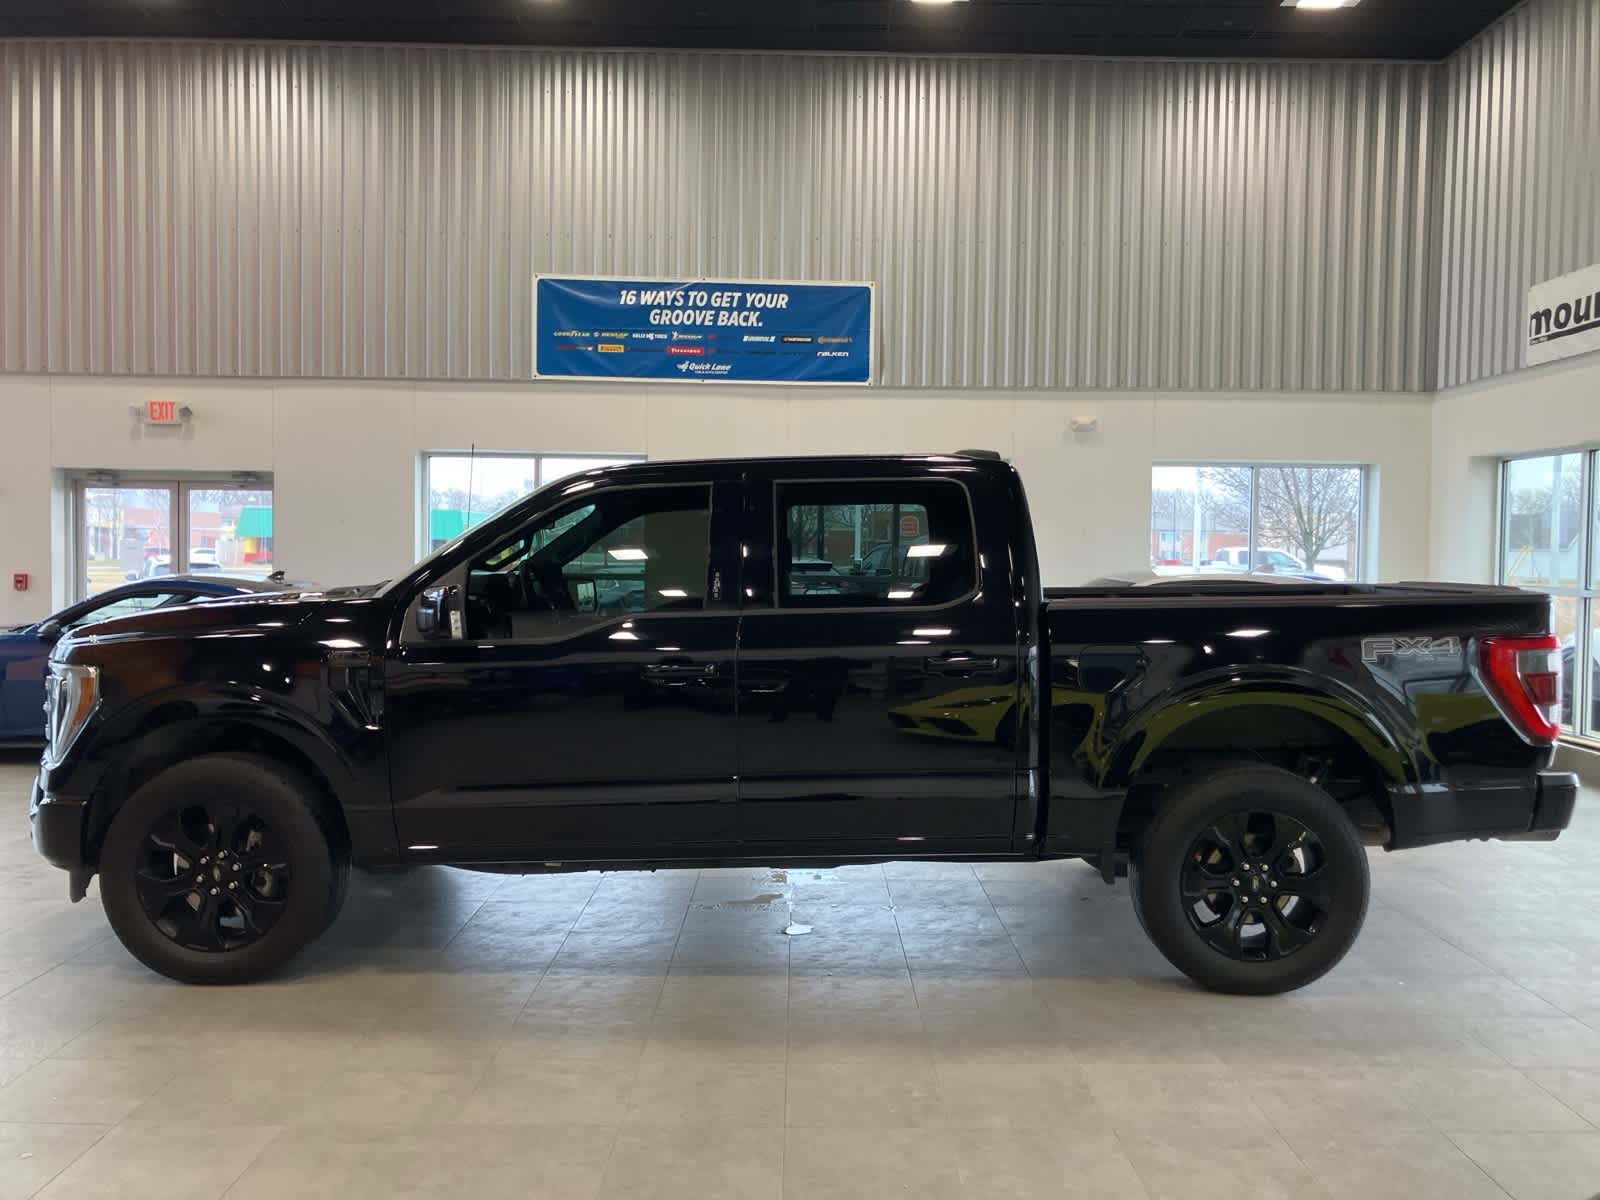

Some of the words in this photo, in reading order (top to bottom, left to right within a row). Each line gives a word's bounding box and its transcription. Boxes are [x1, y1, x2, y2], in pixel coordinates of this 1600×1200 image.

[620, 290, 636, 305] 16
[640, 291, 685, 307] WAYS
[688, 291, 706, 307] TO
[711, 292, 741, 308] GET
[745, 293, 789, 309] YOUR
[649, 309, 715, 326] GROOVE
[717, 311, 763, 327] BACK.
[689, 362, 710, 371] Quick
[711, 363, 732, 371] Lane
[150, 400, 176, 420] EXIT
[1361, 636, 1460, 662] FX4
